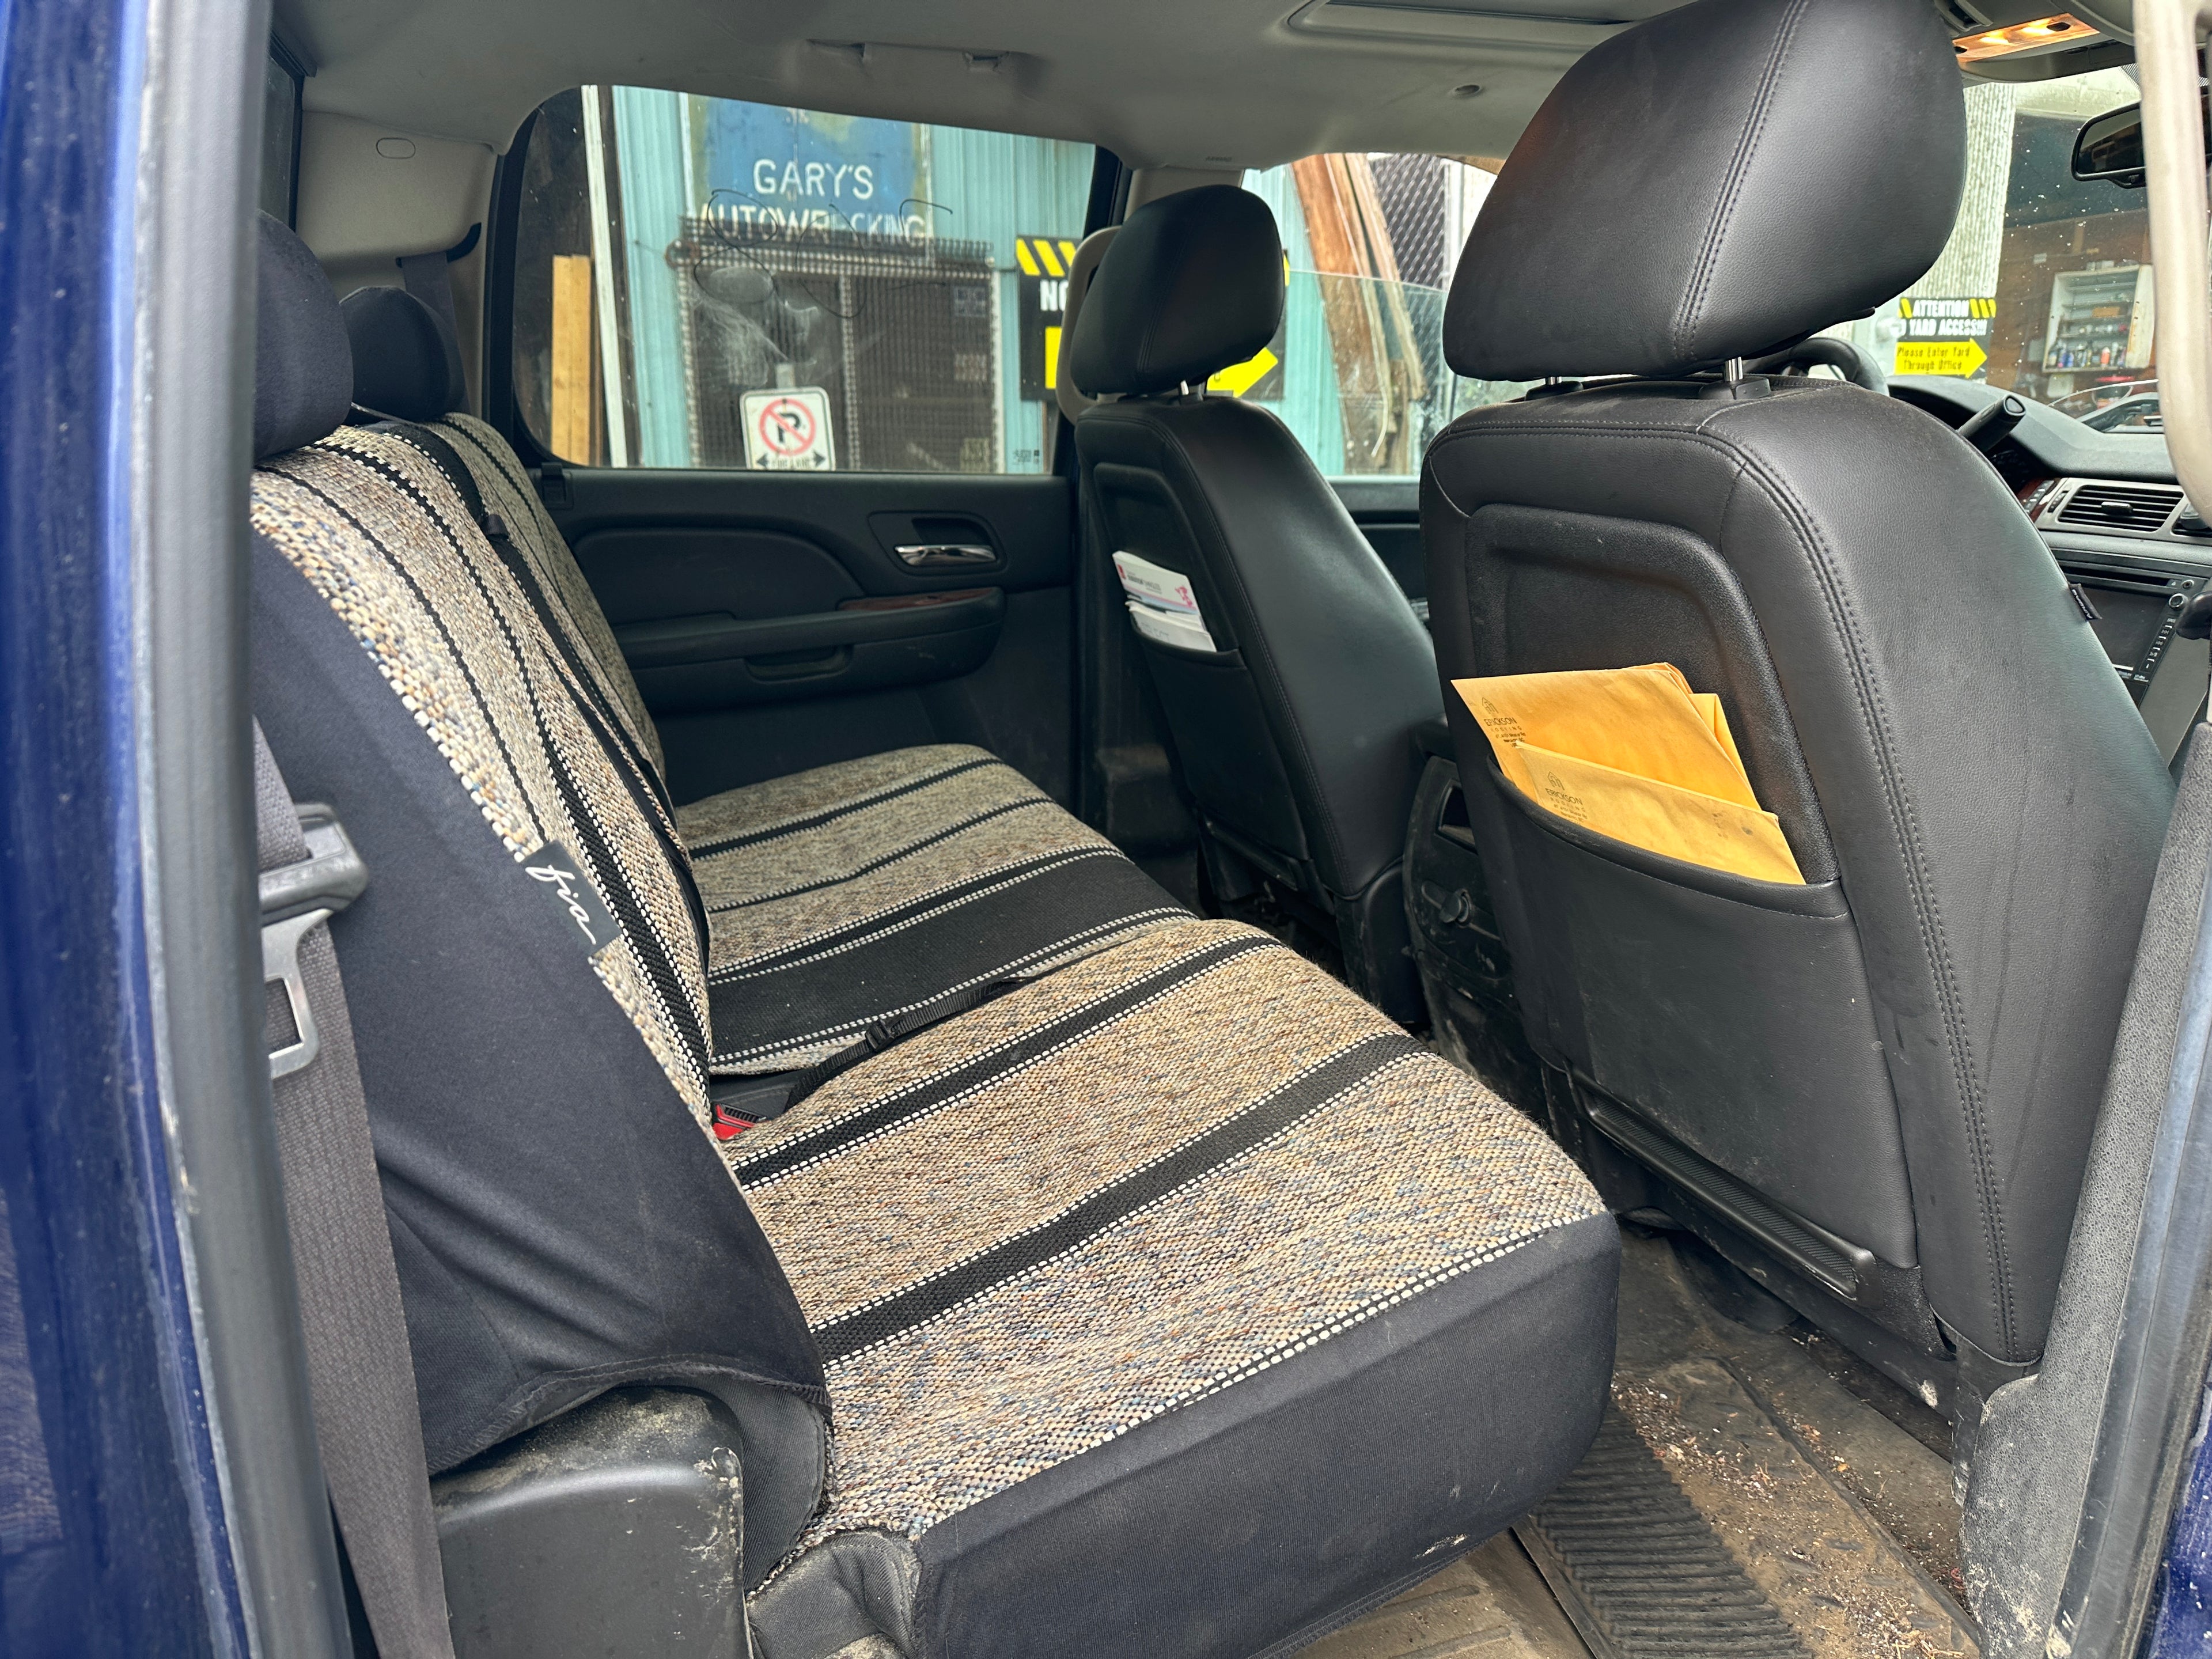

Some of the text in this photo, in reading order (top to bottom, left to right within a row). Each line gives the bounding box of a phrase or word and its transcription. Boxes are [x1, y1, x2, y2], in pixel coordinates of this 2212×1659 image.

[752, 158, 874, 200] GARY'S
[1912, 300, 1970, 317] ATTENTION
[1909, 319, 1937, 336] YARD
[1897, 346, 1971, 357] Please Enter Yard
[1904, 358, 1963, 372] Through Office
[1545, 787, 1583, 805] ERICKSON
